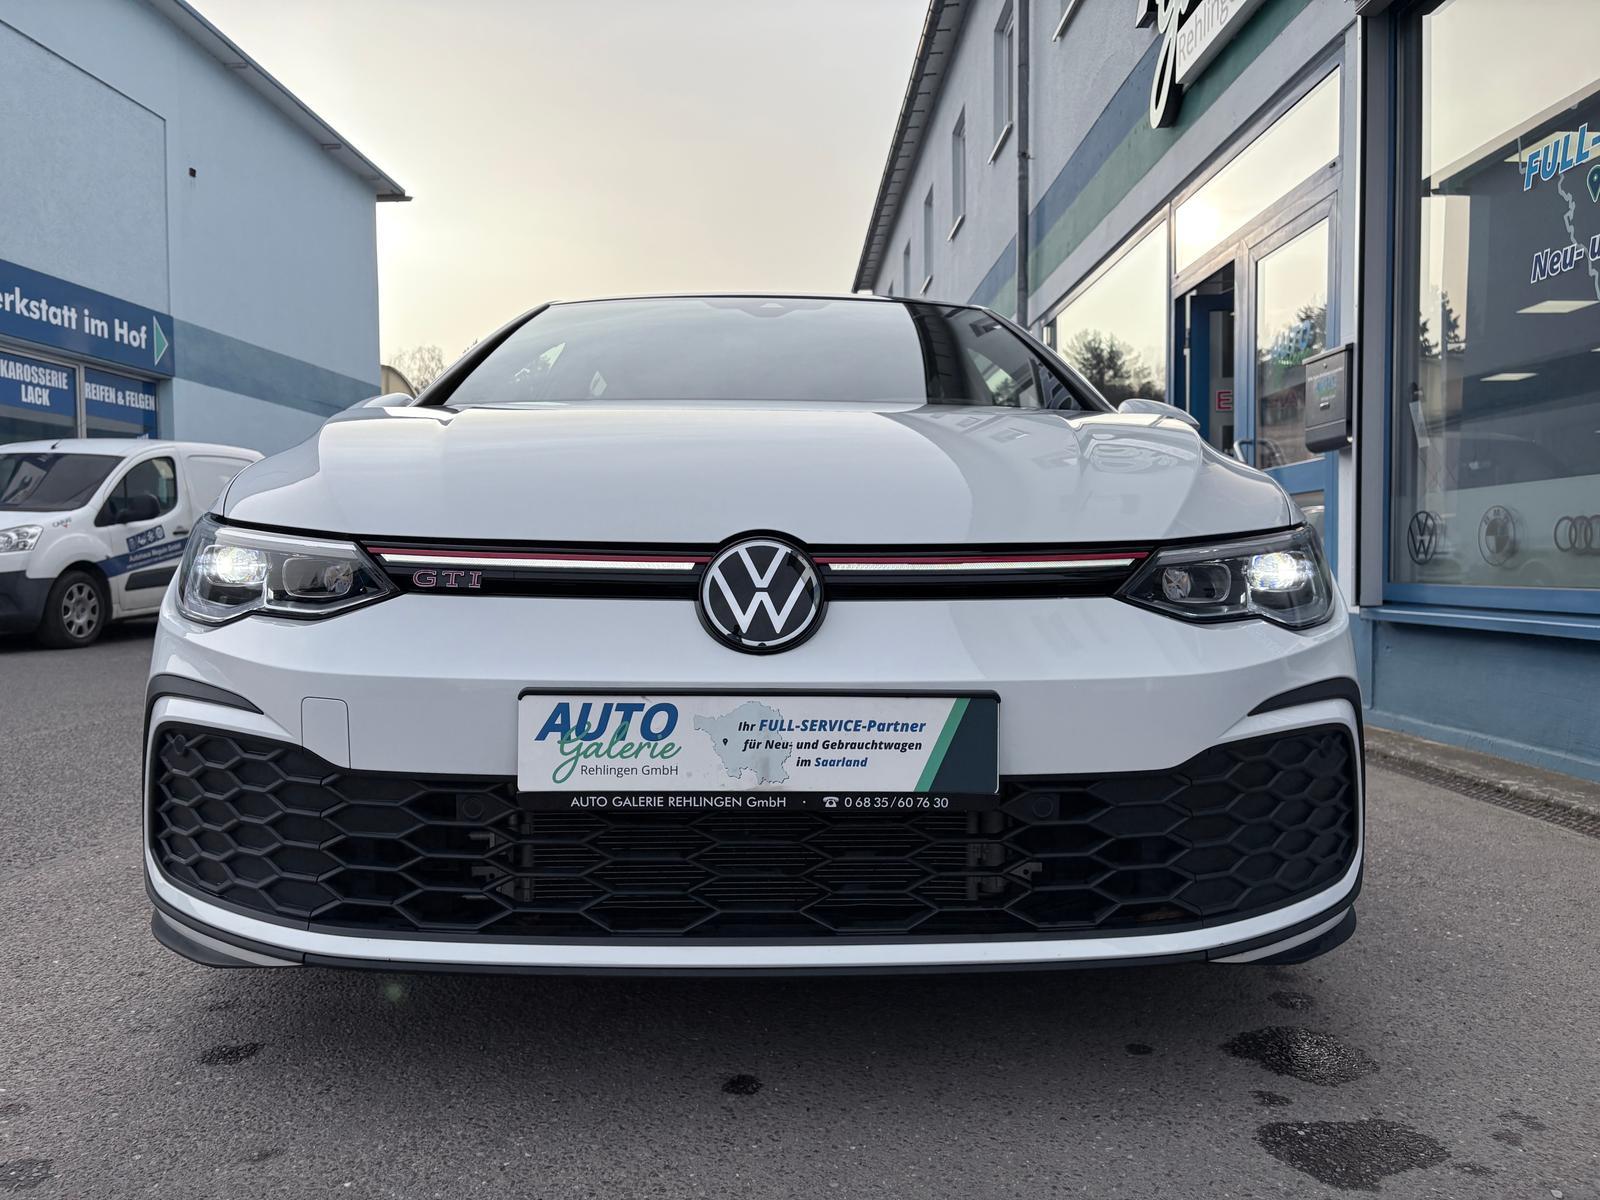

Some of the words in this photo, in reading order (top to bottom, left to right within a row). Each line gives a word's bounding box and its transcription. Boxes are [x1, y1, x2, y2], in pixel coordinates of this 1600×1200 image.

[1178, 0, 1235, 67] Rehling
[1530, 243, 1585, 284] Neu-
[0, 286, 77, 330] rkstatt
[84, 309, 109, 339] im
[114, 319, 147, 349] Hof
[0, 359, 68, 390] KAROSSERIE
[21, 384, 50, 406] LACK
[85, 382, 116, 404] REIFEN
[117, 391, 124, 406] &
[126, 390, 155, 411] FELGEN
[413, 570, 482, 588] GTI
[534, 702, 679, 742] AUTO
[738, 721, 756, 732] Ihr
[759, 719, 926, 733] FULL-SERVICE-Partner
[552, 720, 682, 784] Galerie
[742, 739, 761, 752] für
[764, 740, 793, 751] Neu-
[796, 739, 818, 751] und
[821, 739, 922, 753] Gebrauchtwagen
[580, 764, 638, 778] Rehlingen
[641, 764, 679, 776] GmbH
[796, 757, 811, 768] im
[814, 757, 868, 768] Saarland
[571, 797, 608, 808] AUTO
[612, 797, 664, 808] GALERIE
[668, 797, 742, 808] REHLINGEN
[746, 796, 787, 808] GmbH
